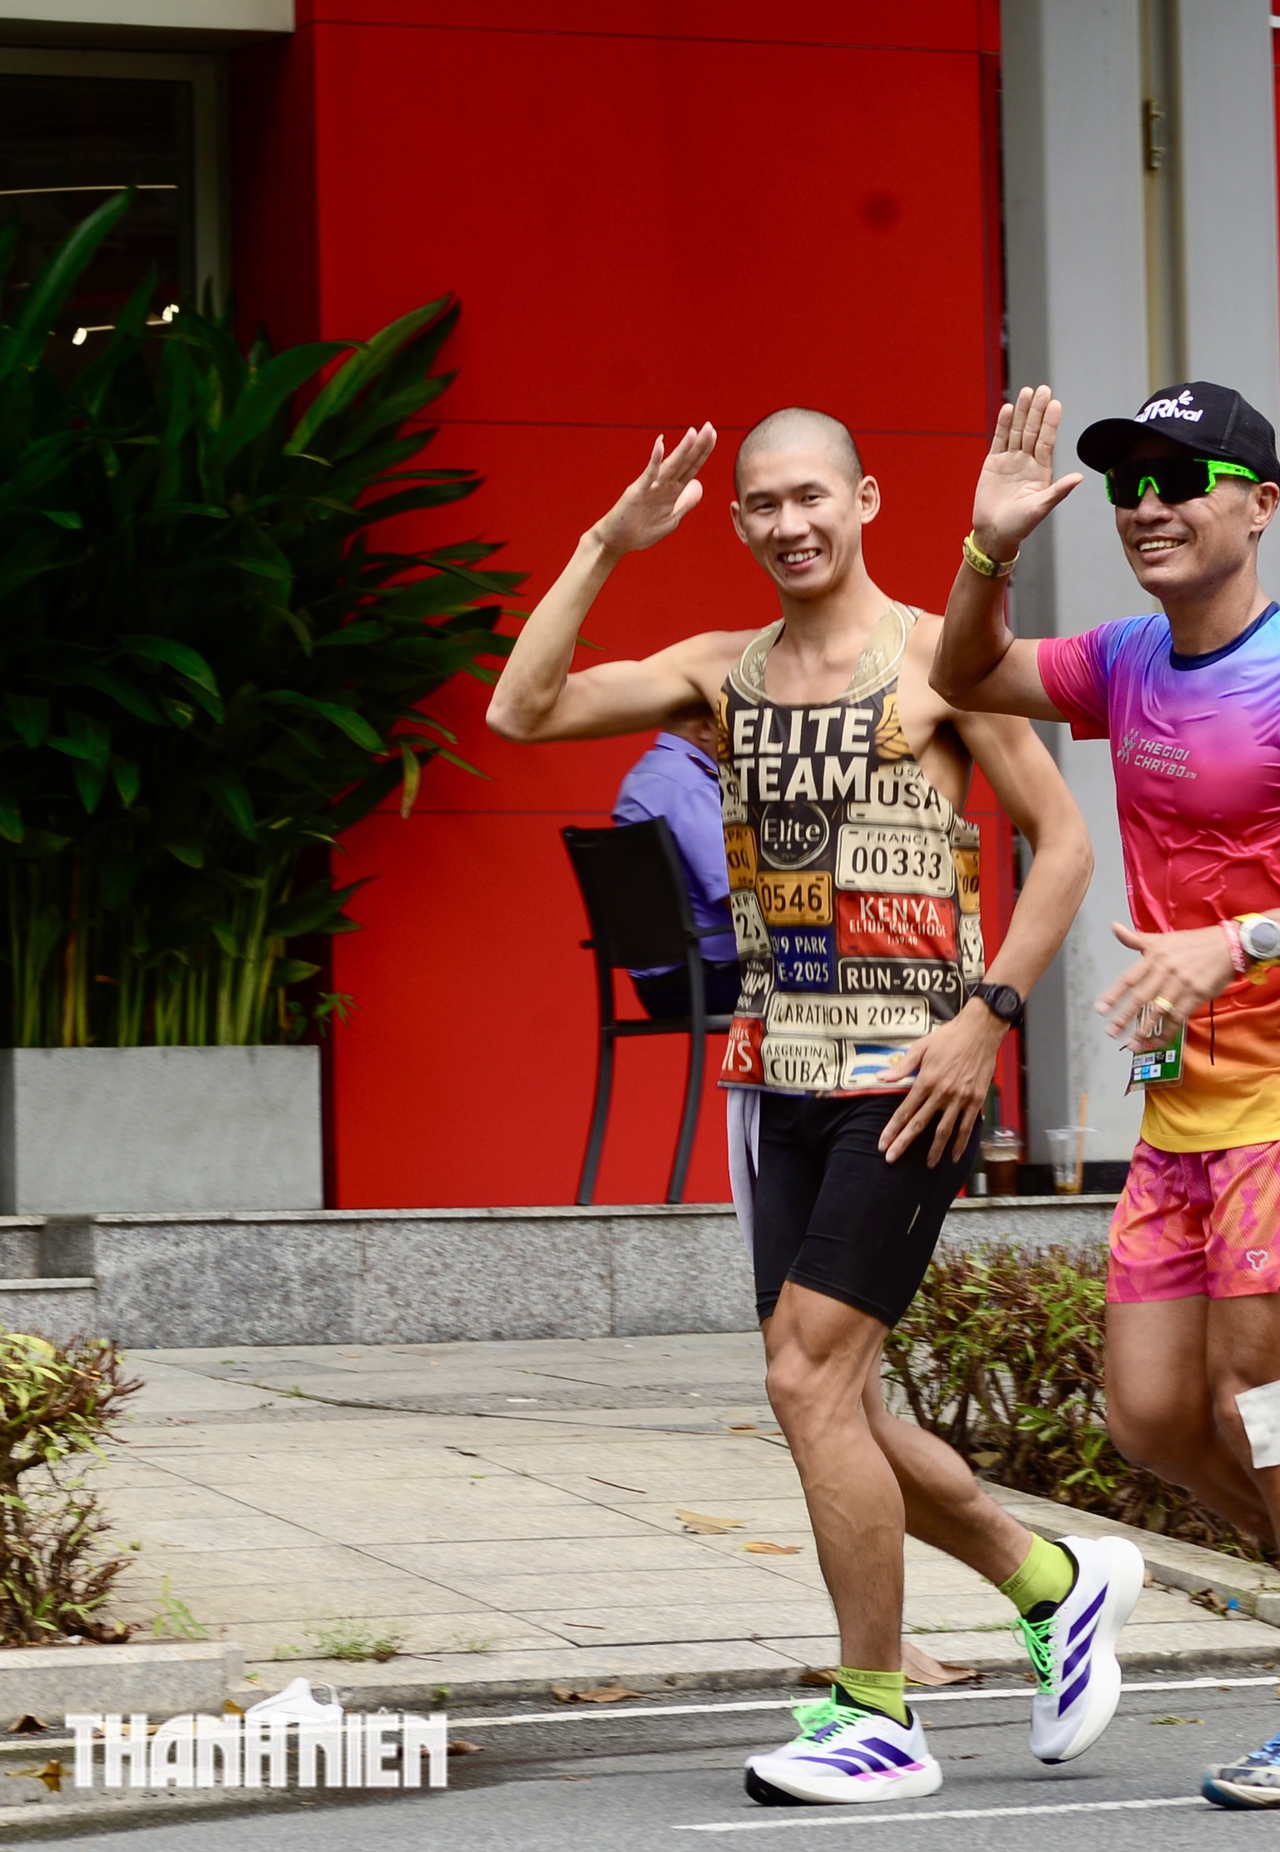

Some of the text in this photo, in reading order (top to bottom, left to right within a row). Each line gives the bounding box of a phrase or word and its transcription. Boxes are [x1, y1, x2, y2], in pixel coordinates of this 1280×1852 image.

[733, 707, 873, 754] ELITE
[733, 756, 868, 802] TEAM
[893, 766, 924, 780] USA
[878, 780, 941, 813] USA
[764, 818, 820, 842] Elite
[867, 832, 929, 847] FRANCE
[852, 847, 942, 880] 00333
[761, 884, 822, 913] 0546
[860, 897, 939, 923] KENYA
[795, 936, 827, 955] PARK
[846, 968, 957, 994] RUN-2025
[867, 1006, 921, 1027] 2025
[766, 1043, 829, 1061] ARGENTINA
[770, 1059, 828, 1084] CUBA
